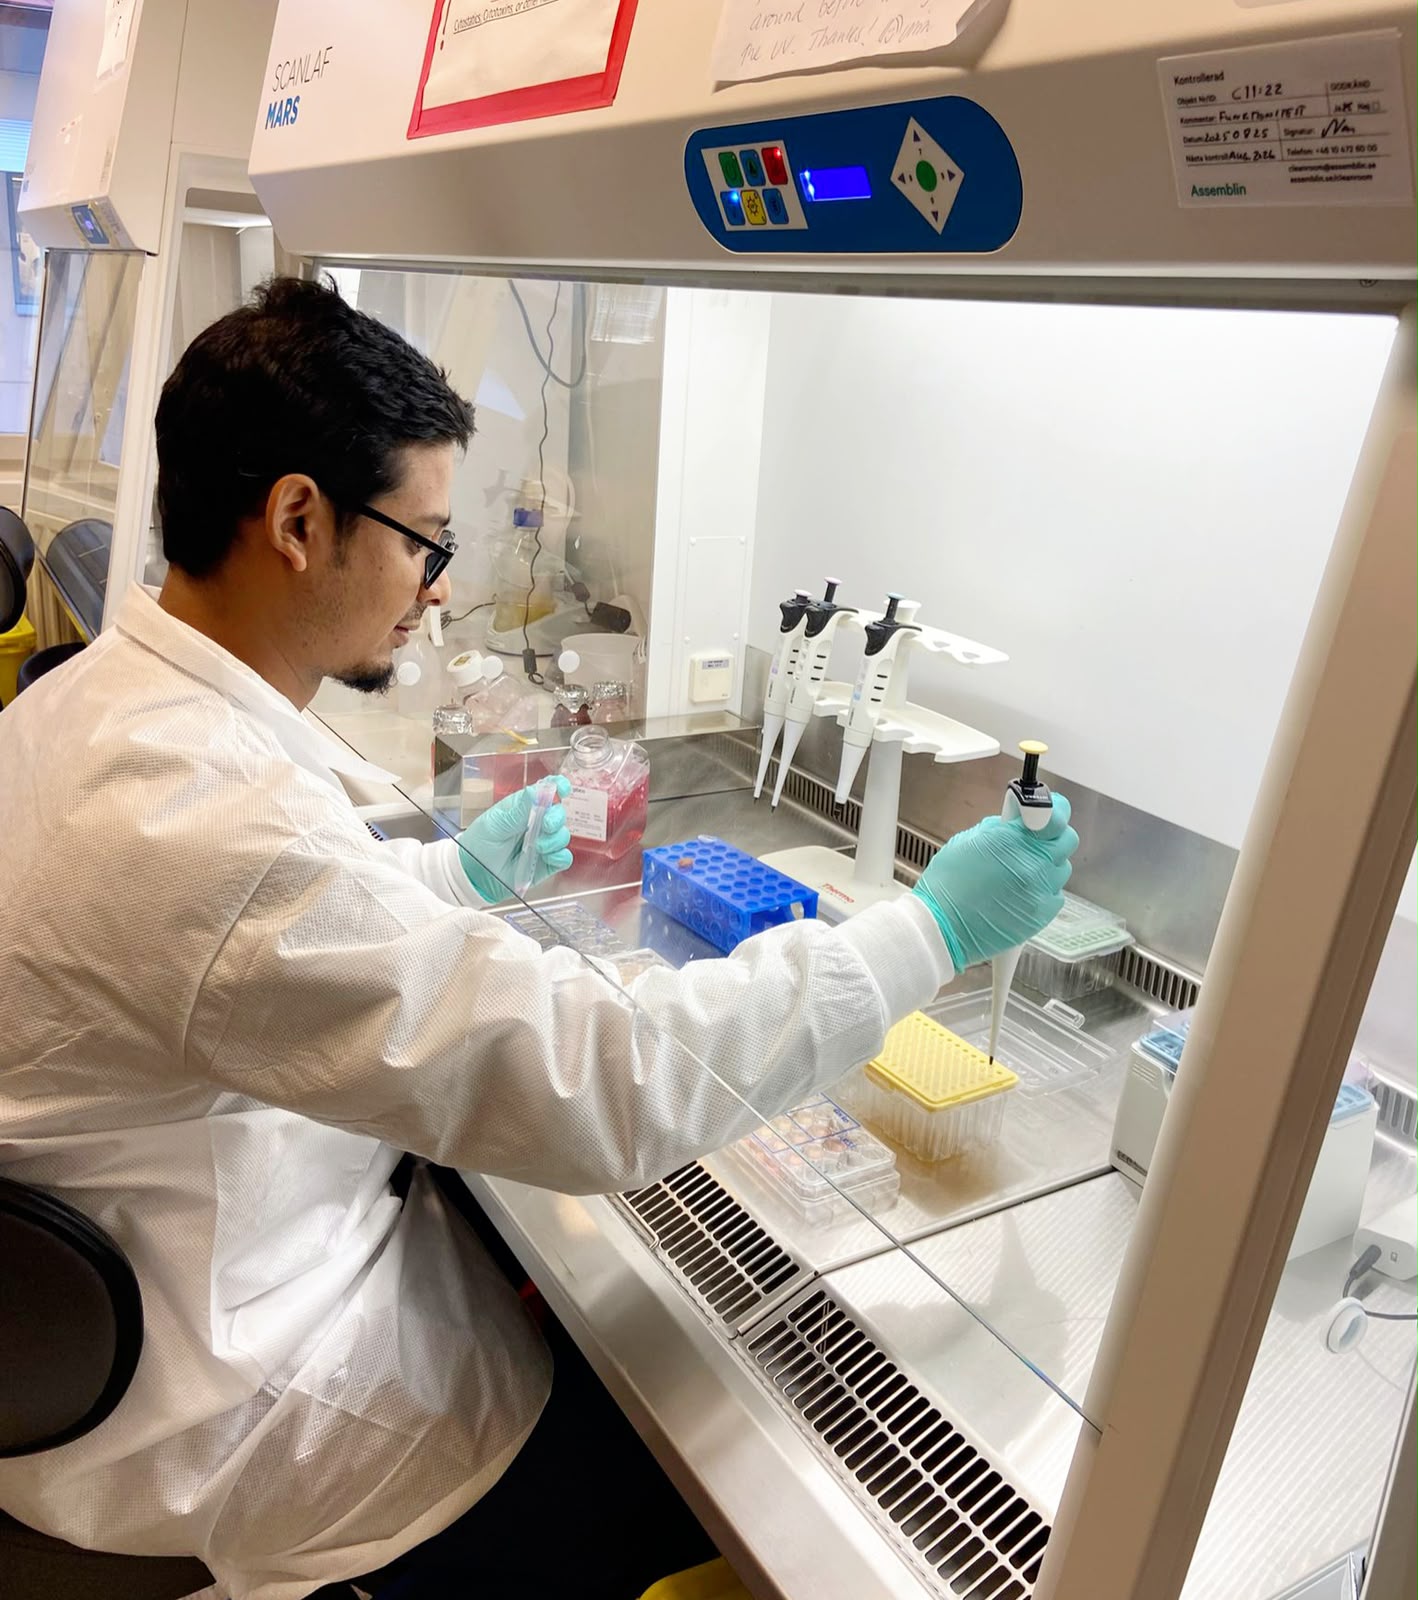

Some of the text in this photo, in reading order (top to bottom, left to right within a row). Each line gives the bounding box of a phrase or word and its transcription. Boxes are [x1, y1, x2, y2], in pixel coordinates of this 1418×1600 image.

[749, 4, 804, 31] around
[272, 46, 333, 92] SCANLAF
[1174, 71, 1225, 85] Kontrollerad
[264, 95, 301, 130] MARS
[1191, 182, 1247, 198] Assemblin
